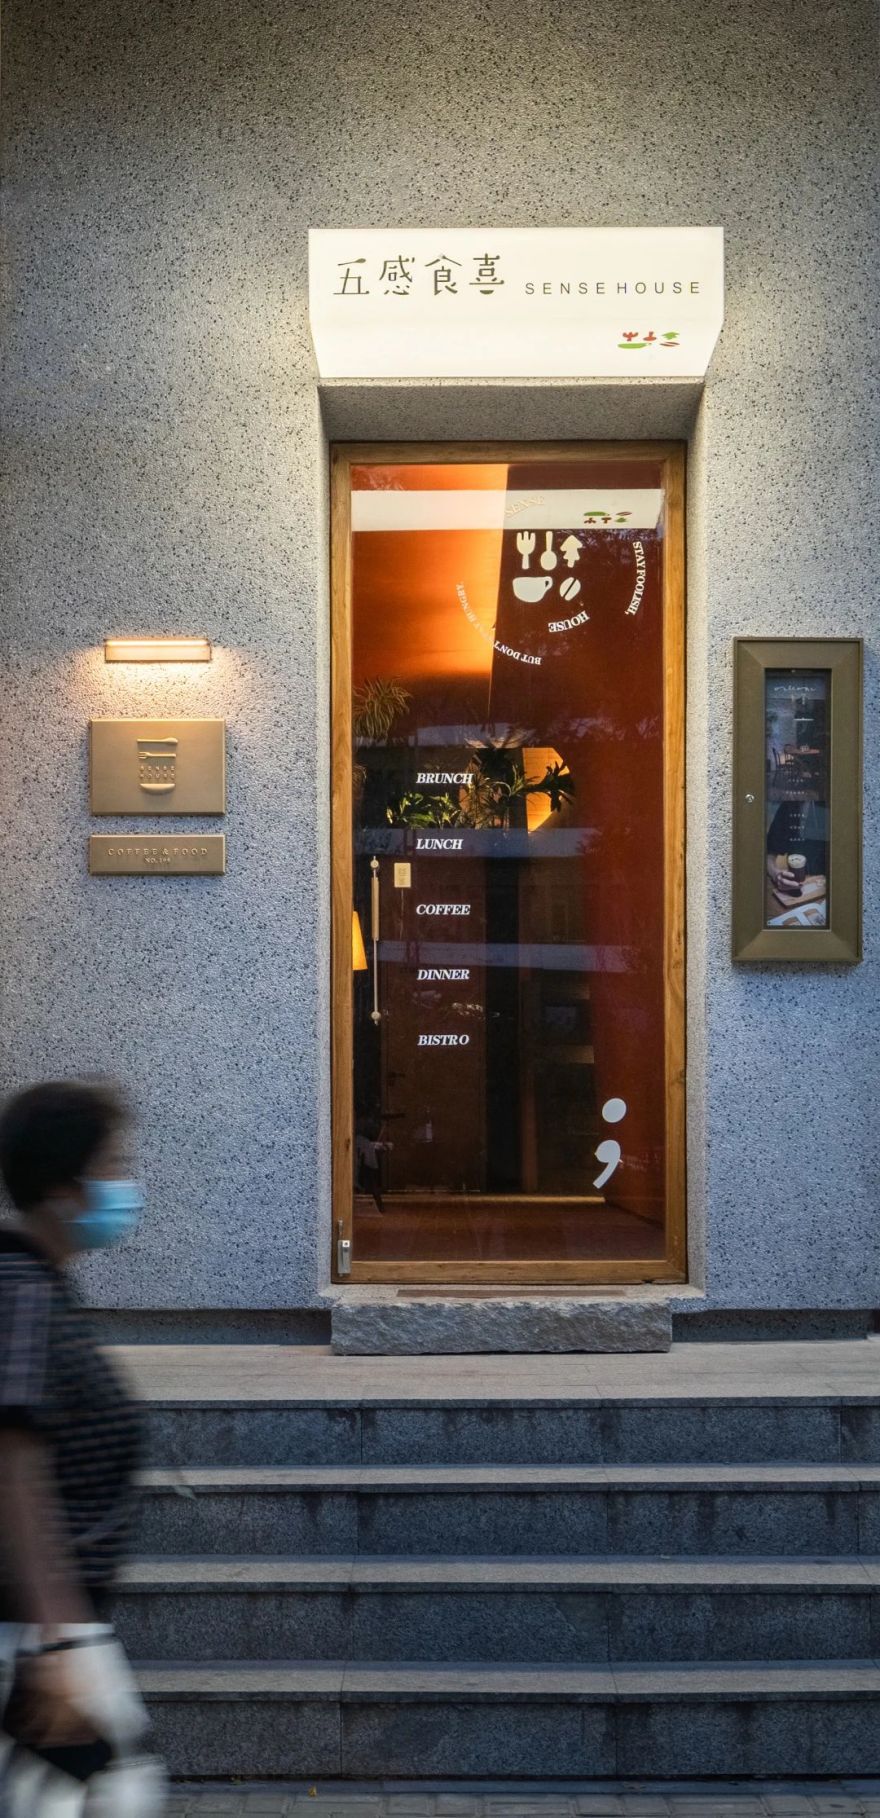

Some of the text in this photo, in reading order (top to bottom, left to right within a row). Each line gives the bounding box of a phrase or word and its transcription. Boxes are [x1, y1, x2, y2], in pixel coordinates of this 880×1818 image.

[333, 253, 505, 296] 五感食喜
[525, 281, 701, 296] SENSE HOUSE
[625, 541, 646, 616] STAY FOOLISH,
[548, 610, 590, 633] HOUSE
[520, 655, 542, 665] BUT
[416, 772, 474, 785] BRUNCH
[416, 838, 463, 850] LUNCH
[108, 848, 158, 856] COFFEE
[174, 848, 208, 856] FOOD
[416, 904, 471, 916] COFFEE
[417, 969, 470, 981] DINNER
[418, 1034, 470, 1046] BISTRO
